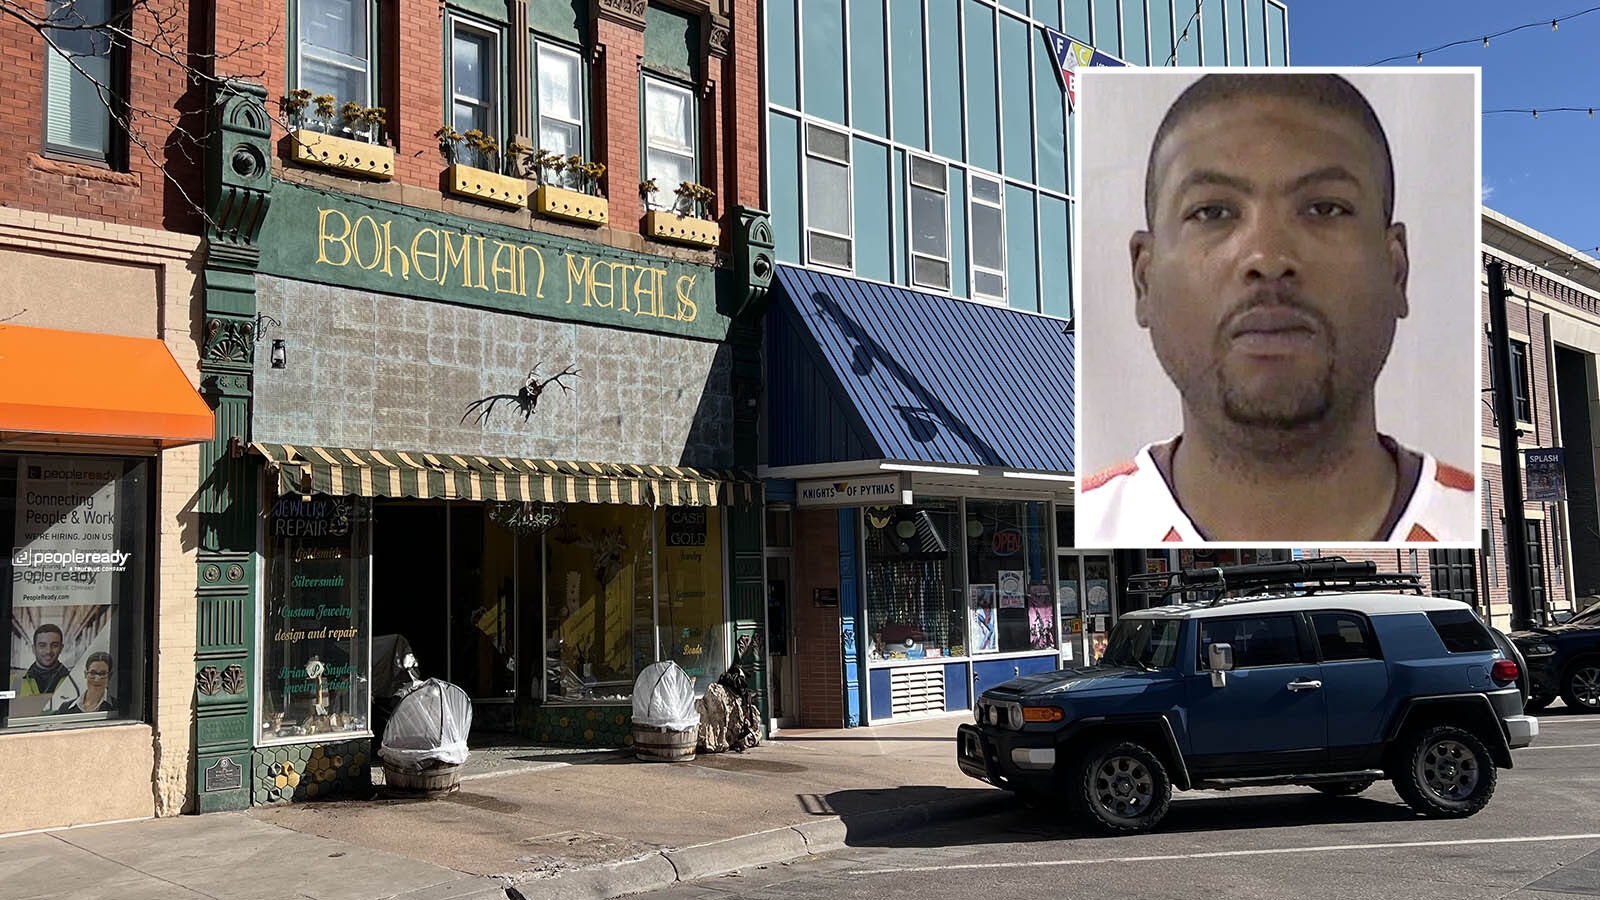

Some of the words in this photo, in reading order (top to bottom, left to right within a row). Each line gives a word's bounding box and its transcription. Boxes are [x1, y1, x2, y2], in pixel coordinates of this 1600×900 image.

[1529, 454, 1559, 463] SPLASH
[802, 487, 835, 499] KNIGHTS
[846, 486, 857, 496] OF
[860, 483, 895, 496] PYTHIAS
[26, 491, 94, 510] Connecting
[26, 510, 67, 527] People
[70, 510, 81, 525] &
[83, 510, 115, 525] Work
[672, 512, 705, 525] CASH
[275, 519, 328, 537] REPAIR
[25, 533, 49, 541] WE'RE
[51, 533, 80, 541] HIRING.
[82, 533, 100, 541] JOIN
[670, 533, 706, 545] GOLD
[992, 533, 1022, 552] OPEN
[34, 549, 128, 567] peopleready
[292, 574, 344, 588] Silversmith
[280, 604, 316, 618] Custom
[314, 603, 353, 622] Jewelry
[274, 627, 306, 642] design
[307, 625, 327, 639] and
[328, 621, 358, 640] repair
[278, 665, 307, 680] Brian
